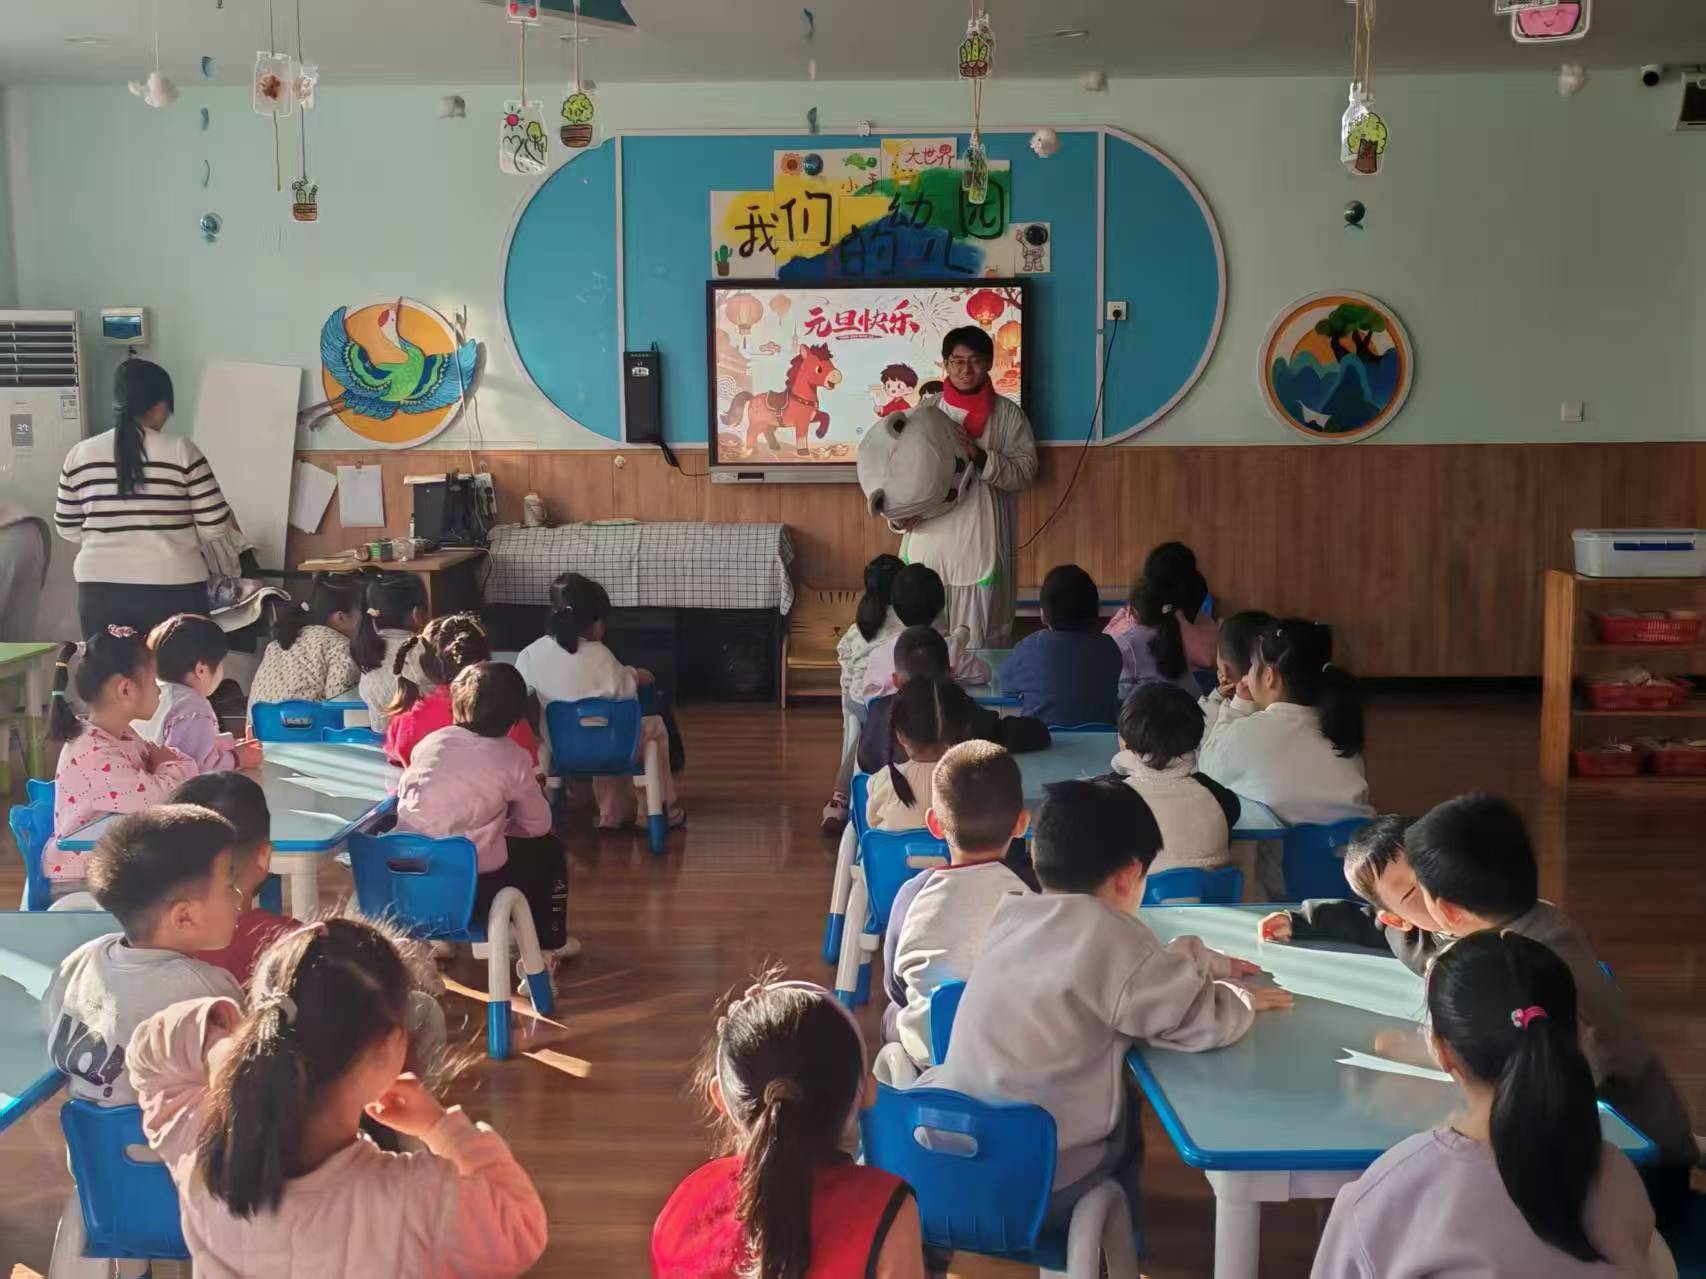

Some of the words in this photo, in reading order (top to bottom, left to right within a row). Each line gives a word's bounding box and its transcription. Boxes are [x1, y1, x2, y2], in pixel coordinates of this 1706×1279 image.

[905, 143, 955, 168] 大世界
[804, 299, 920, 338] 元旦快乐
